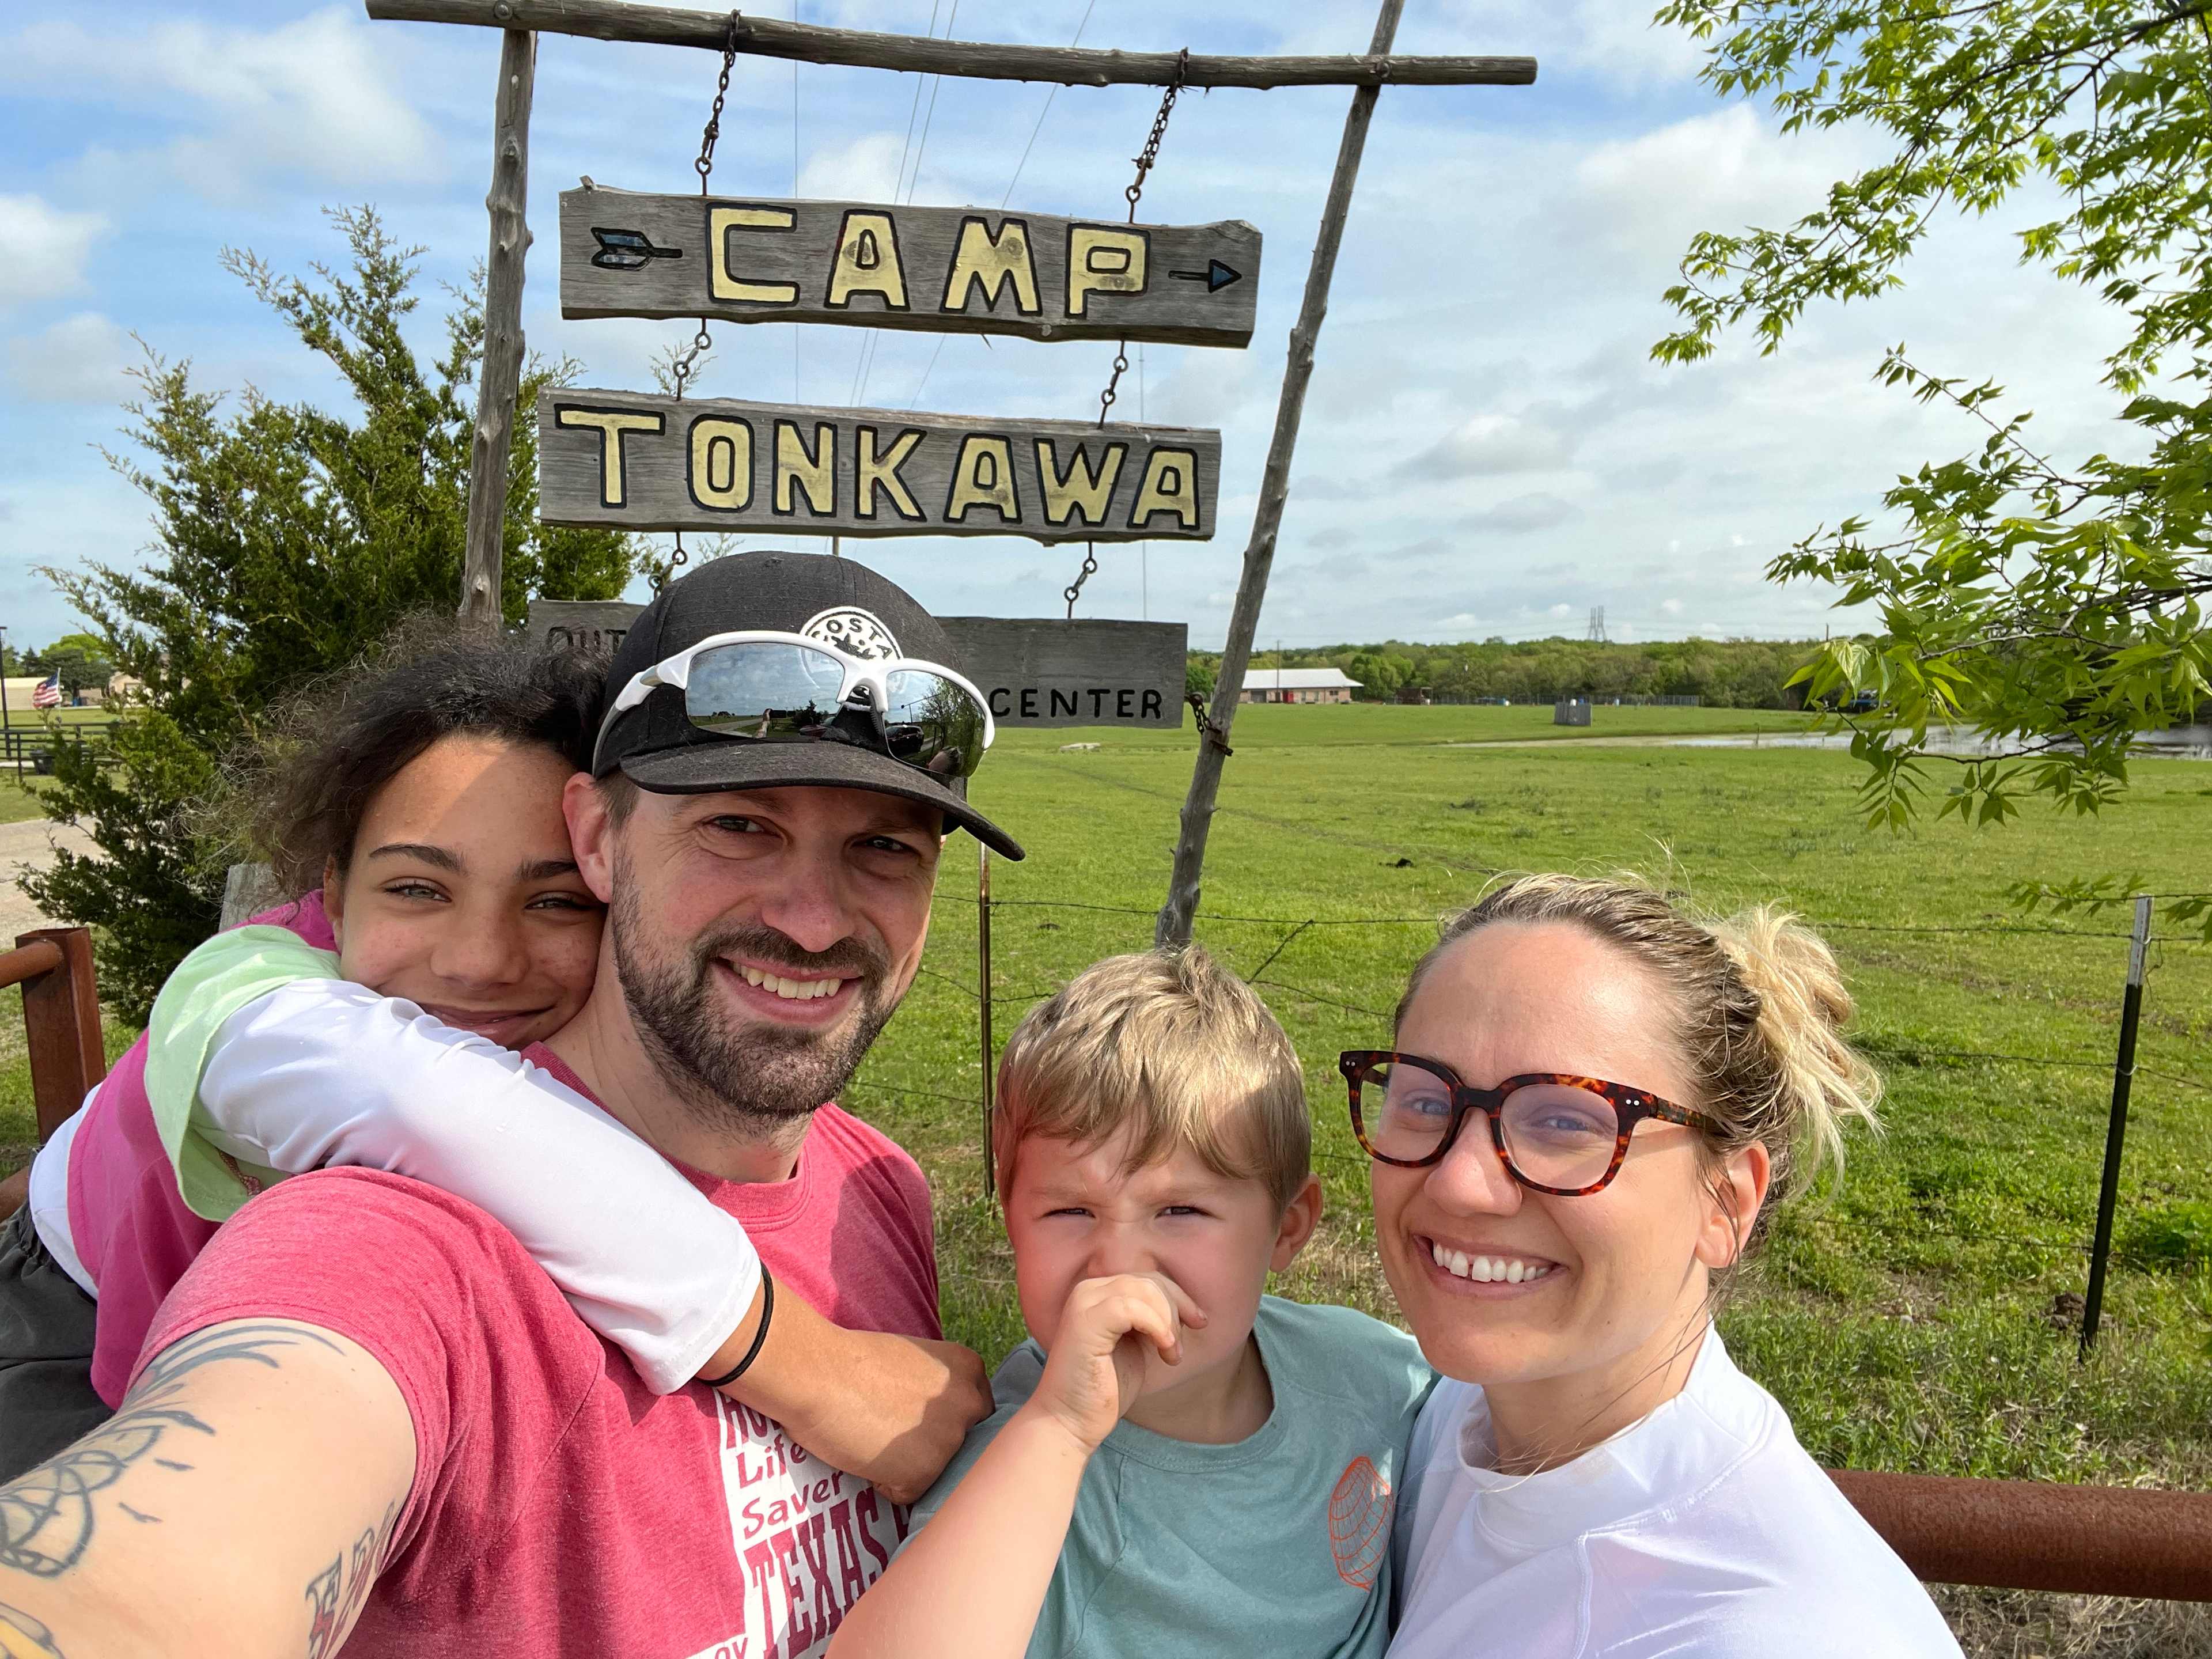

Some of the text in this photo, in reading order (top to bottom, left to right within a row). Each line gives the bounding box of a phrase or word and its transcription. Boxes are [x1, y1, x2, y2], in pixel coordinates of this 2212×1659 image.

[705, 202, 1151, 318] CAMP
[555, 404, 1201, 530] TONKAWA
[988, 688, 1162, 719] CENTER
[736, 1433, 806, 1489] Life
[742, 1470, 844, 1539] Saver
[743, 1487, 888, 1659] TEXAS
